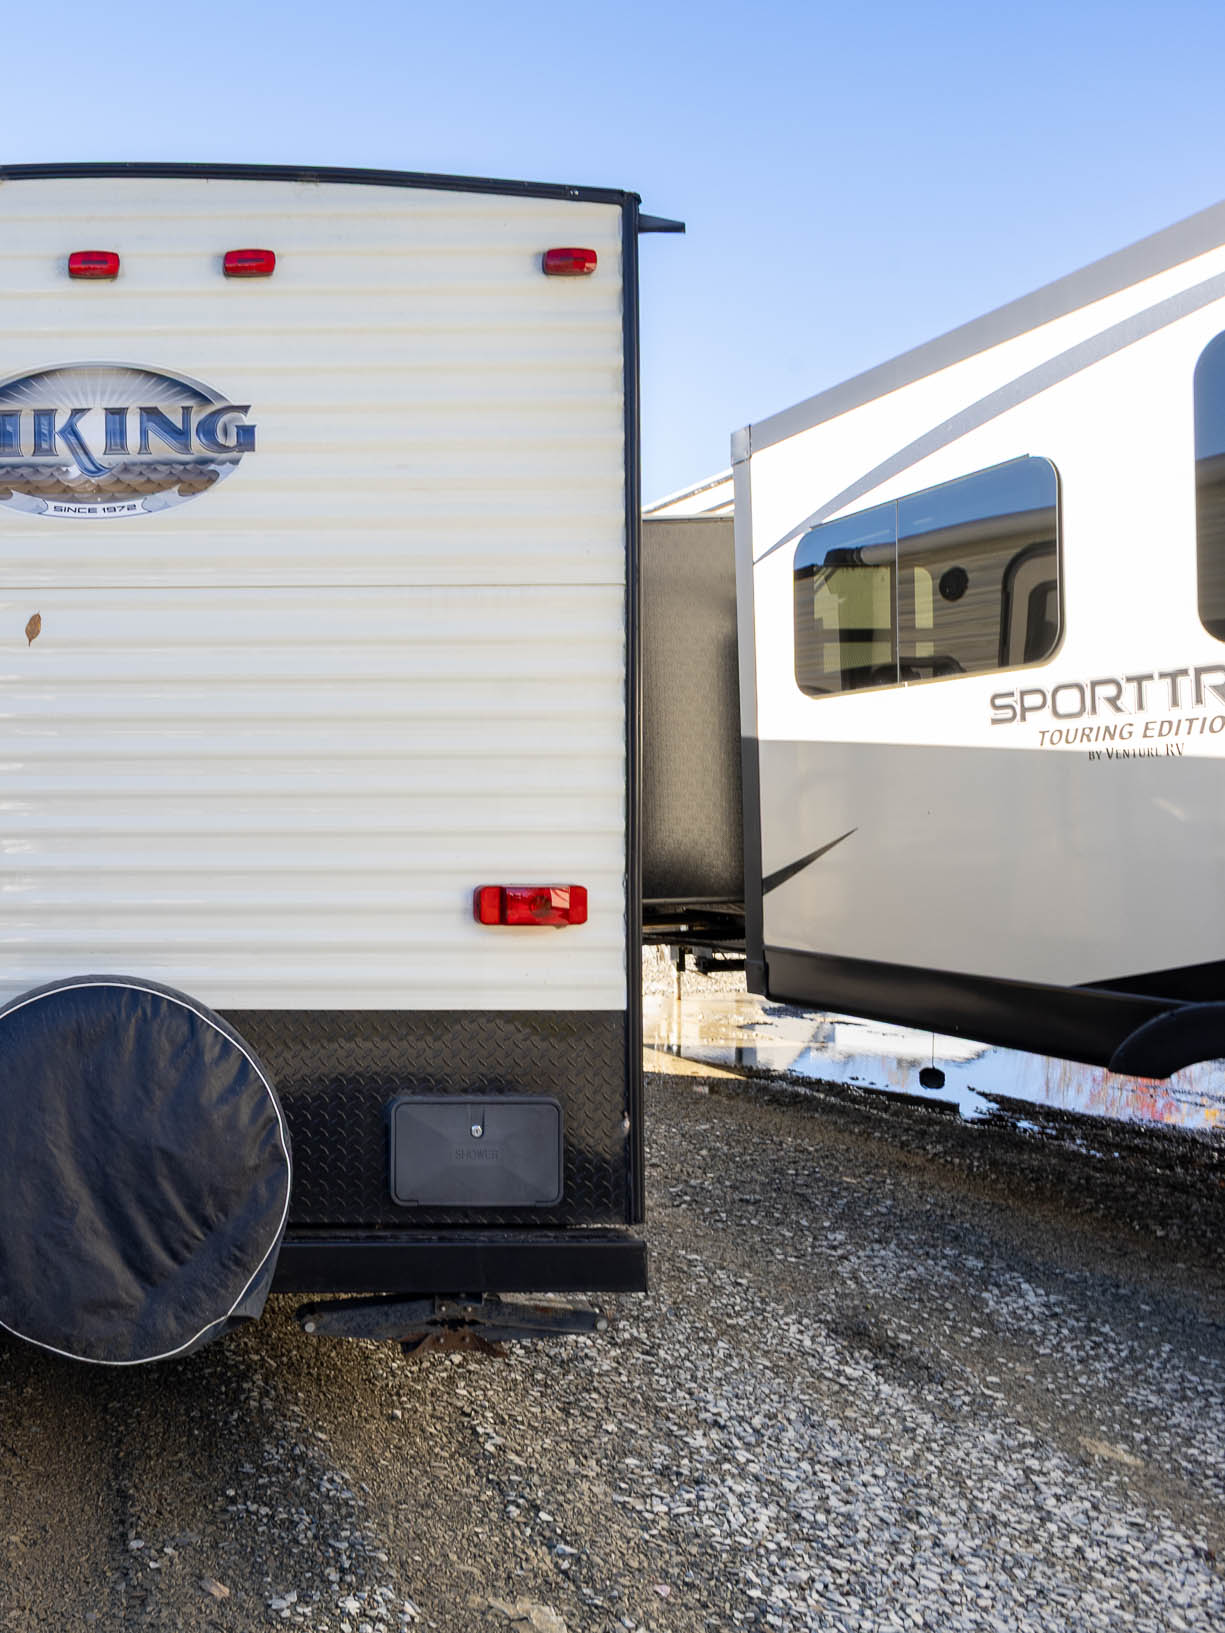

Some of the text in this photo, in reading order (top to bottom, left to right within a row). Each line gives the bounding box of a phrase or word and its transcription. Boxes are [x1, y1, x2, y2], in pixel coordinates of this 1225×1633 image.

[54, 504, 136, 513] SINCE 1972
[1039, 716, 1225, 747] TOURING EDITIO
[1088, 751, 1102, 761] BY
[1166, 742, 1185, 756] RV
